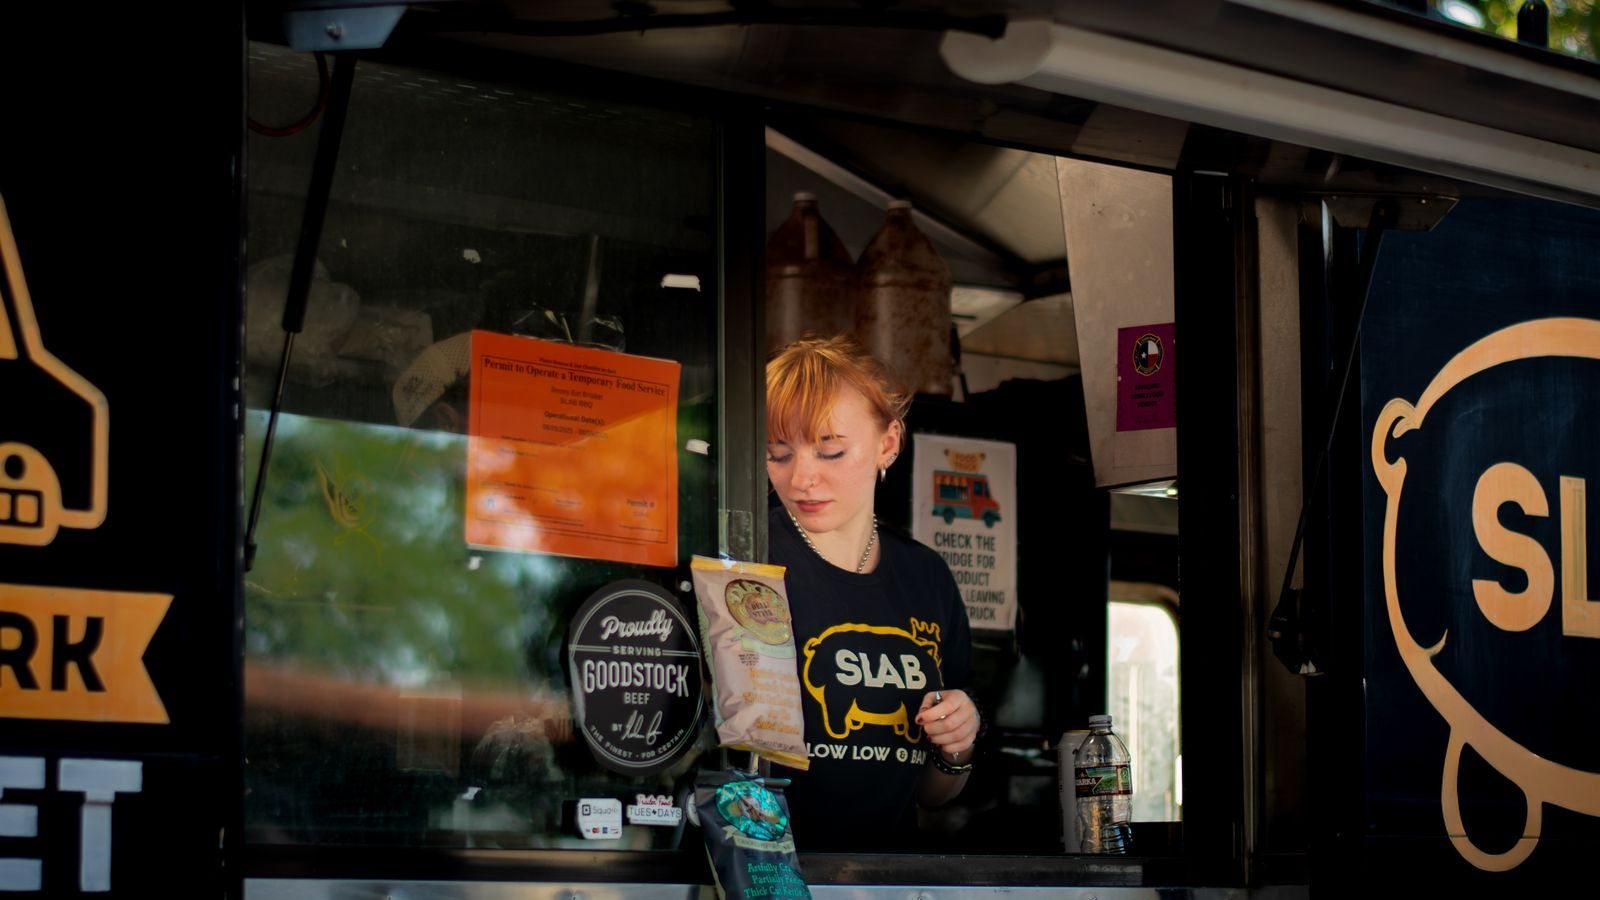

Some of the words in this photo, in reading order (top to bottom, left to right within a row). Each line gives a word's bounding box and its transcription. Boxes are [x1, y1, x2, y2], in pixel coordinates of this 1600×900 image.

[485, 357, 513, 372] Permit
[514, 361, 525, 373] to
[526, 365, 560, 381] Operate
[561, 372, 567, 380] a
[569, 371, 614, 389] Temporary
[616, 377, 636, 391] Food
[637, 382, 667, 397] Service
[934, 532, 973, 549] CHECK
[976, 535, 996, 552] THE
[977, 554, 996, 569] FOR
[951, 569, 990, 586] ODUCT
[966, 589, 1005, 604] LEAVING
[600, 609, 674, 643] Proudly
[612, 645, 662, 657] SERVING
[835, 648, 927, 690] SLAB
[583, 659, 689, 698] GOODSTOCK
[624, 692, 651, 705] BEEF
[611, 723, 622, 732] BY
[590, 725, 604, 742] THE
[604, 741, 633, 758] FINEST
[641, 750, 656, 759] FOR
[657, 728, 685, 755] CERTAIN
[852, 745, 890, 761] LOW
[747, 862, 778, 873] Artfully
[752, 873, 784, 885] Partially
[743, 886, 767, 898] Thick
